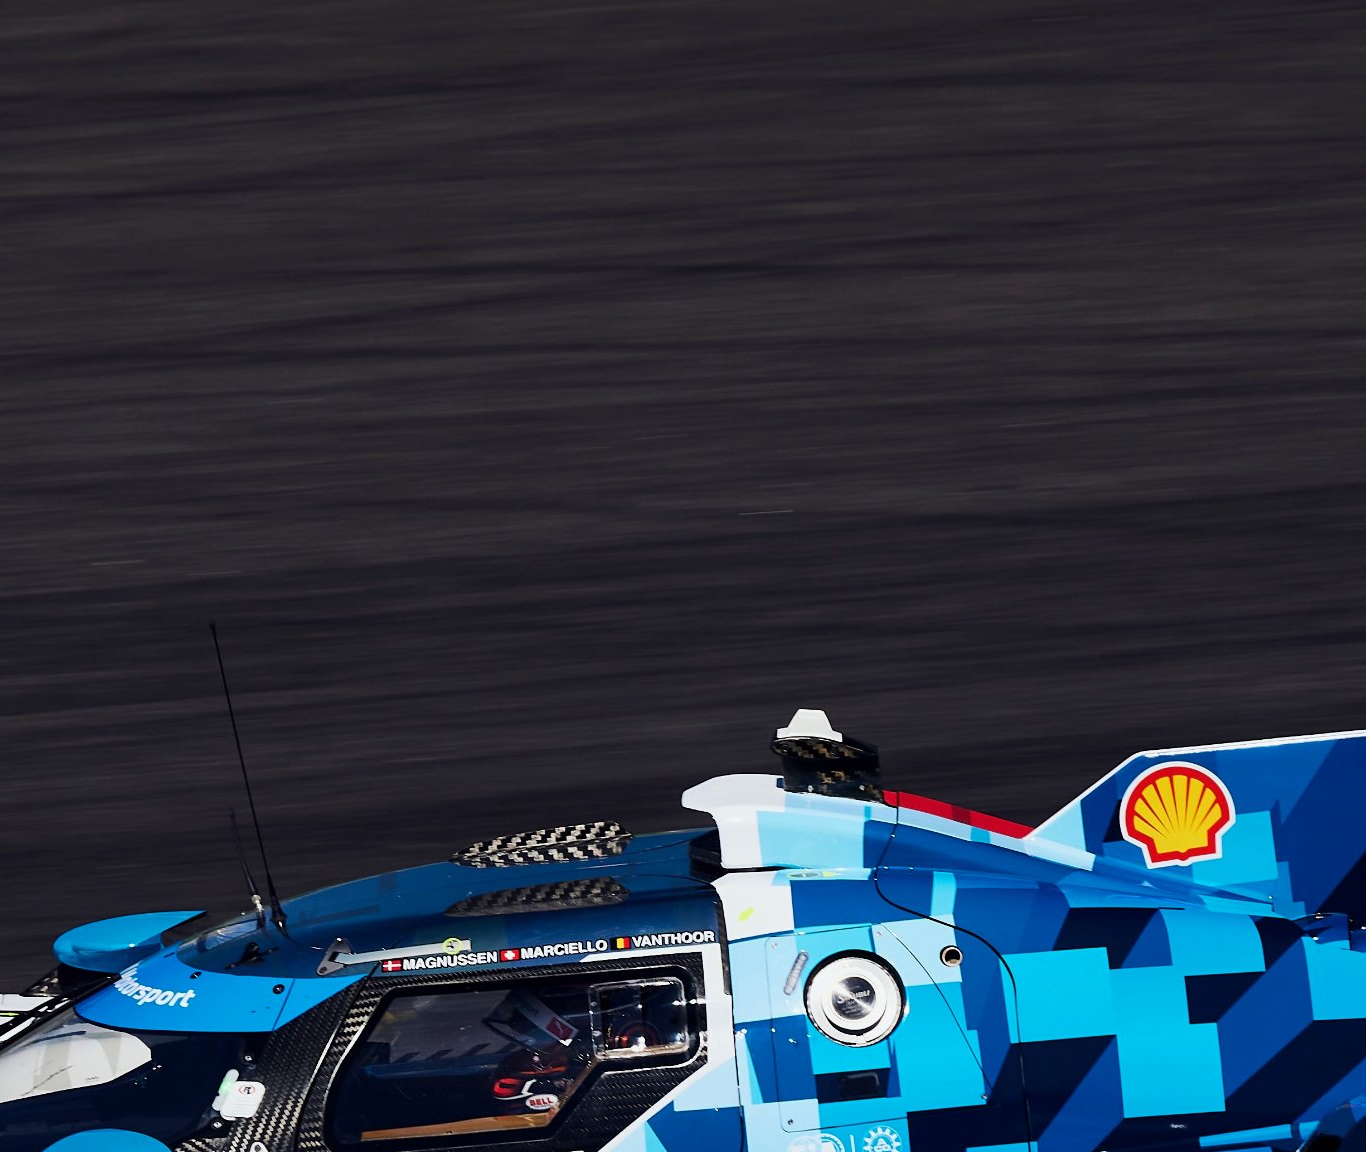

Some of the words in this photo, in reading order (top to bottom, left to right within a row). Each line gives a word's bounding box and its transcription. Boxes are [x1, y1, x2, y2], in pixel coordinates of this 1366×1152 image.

[631, 930, 716, 948] VANTHOOR
[402, 950, 498, 971] MAGNUSSEN
[520, 939, 609, 961] MARCIELLO
